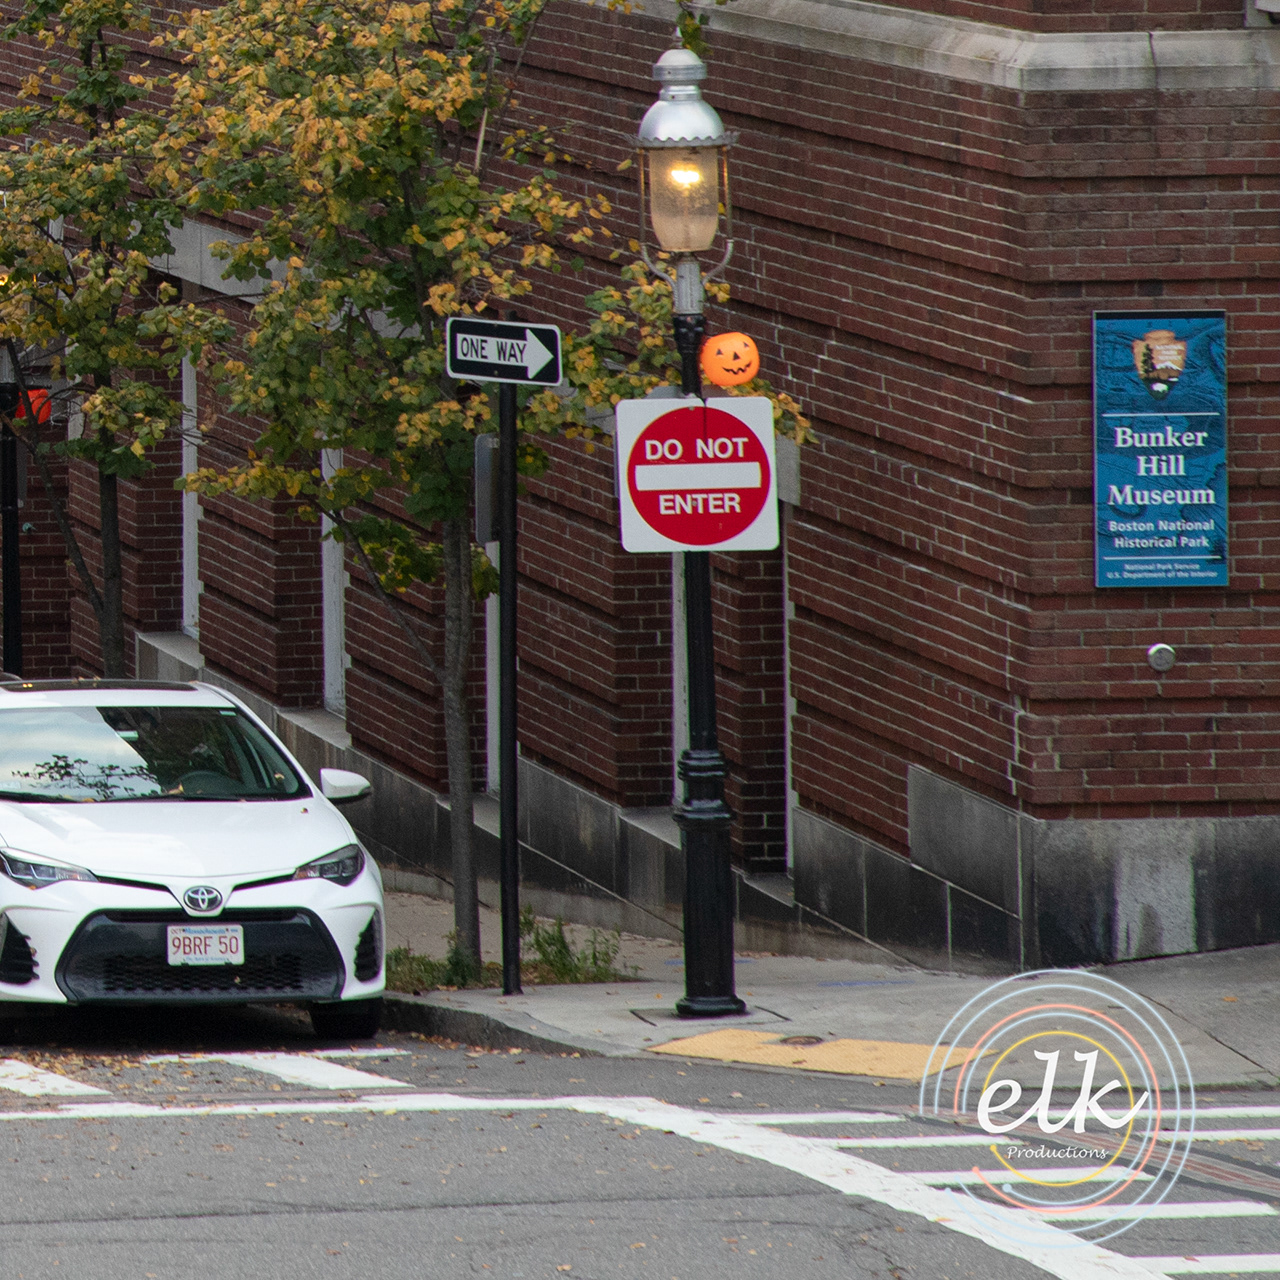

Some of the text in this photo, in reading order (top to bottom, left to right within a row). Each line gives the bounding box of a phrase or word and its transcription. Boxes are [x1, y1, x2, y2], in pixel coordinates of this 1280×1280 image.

[461, 337, 527, 363] ONE WAY
[1114, 426, 1209, 448] Bunker
[645, 437, 749, 460] DO NOT
[1137, 455, 1187, 476] Hill
[659, 493, 741, 515] ENTER
[1107, 485, 1217, 506] Museum
[1109, 519, 1215, 532] Boston National
[1114, 535, 1209, 548] Historical Park
[172, 935, 239, 956] 9BRF 50
